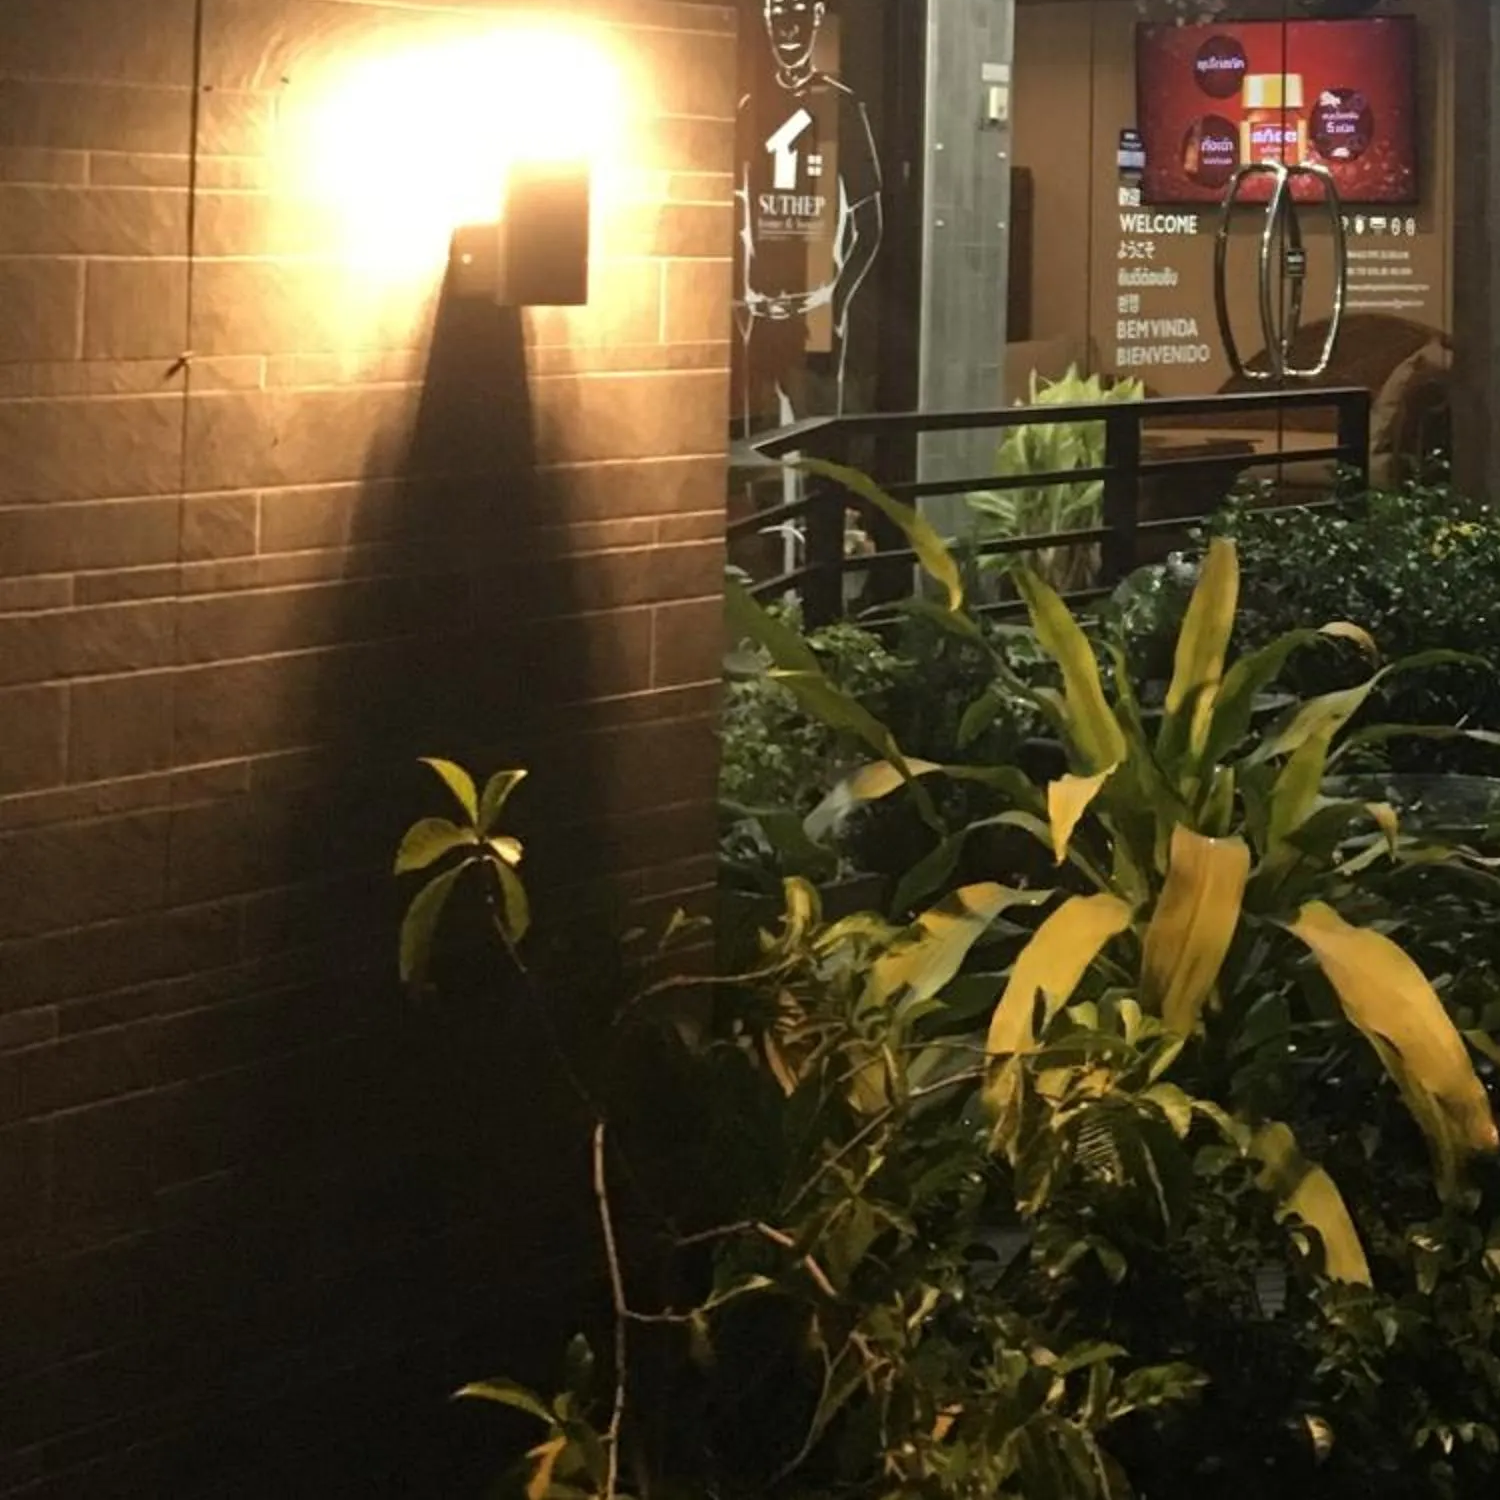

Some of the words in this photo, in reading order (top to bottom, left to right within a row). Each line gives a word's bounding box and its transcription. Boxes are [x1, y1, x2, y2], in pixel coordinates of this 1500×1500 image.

[759, 194, 826, 216] SUTHEP
[1119, 213, 1198, 234] WELCOME
[1116, 344, 1211, 367] BIENVENIDO
